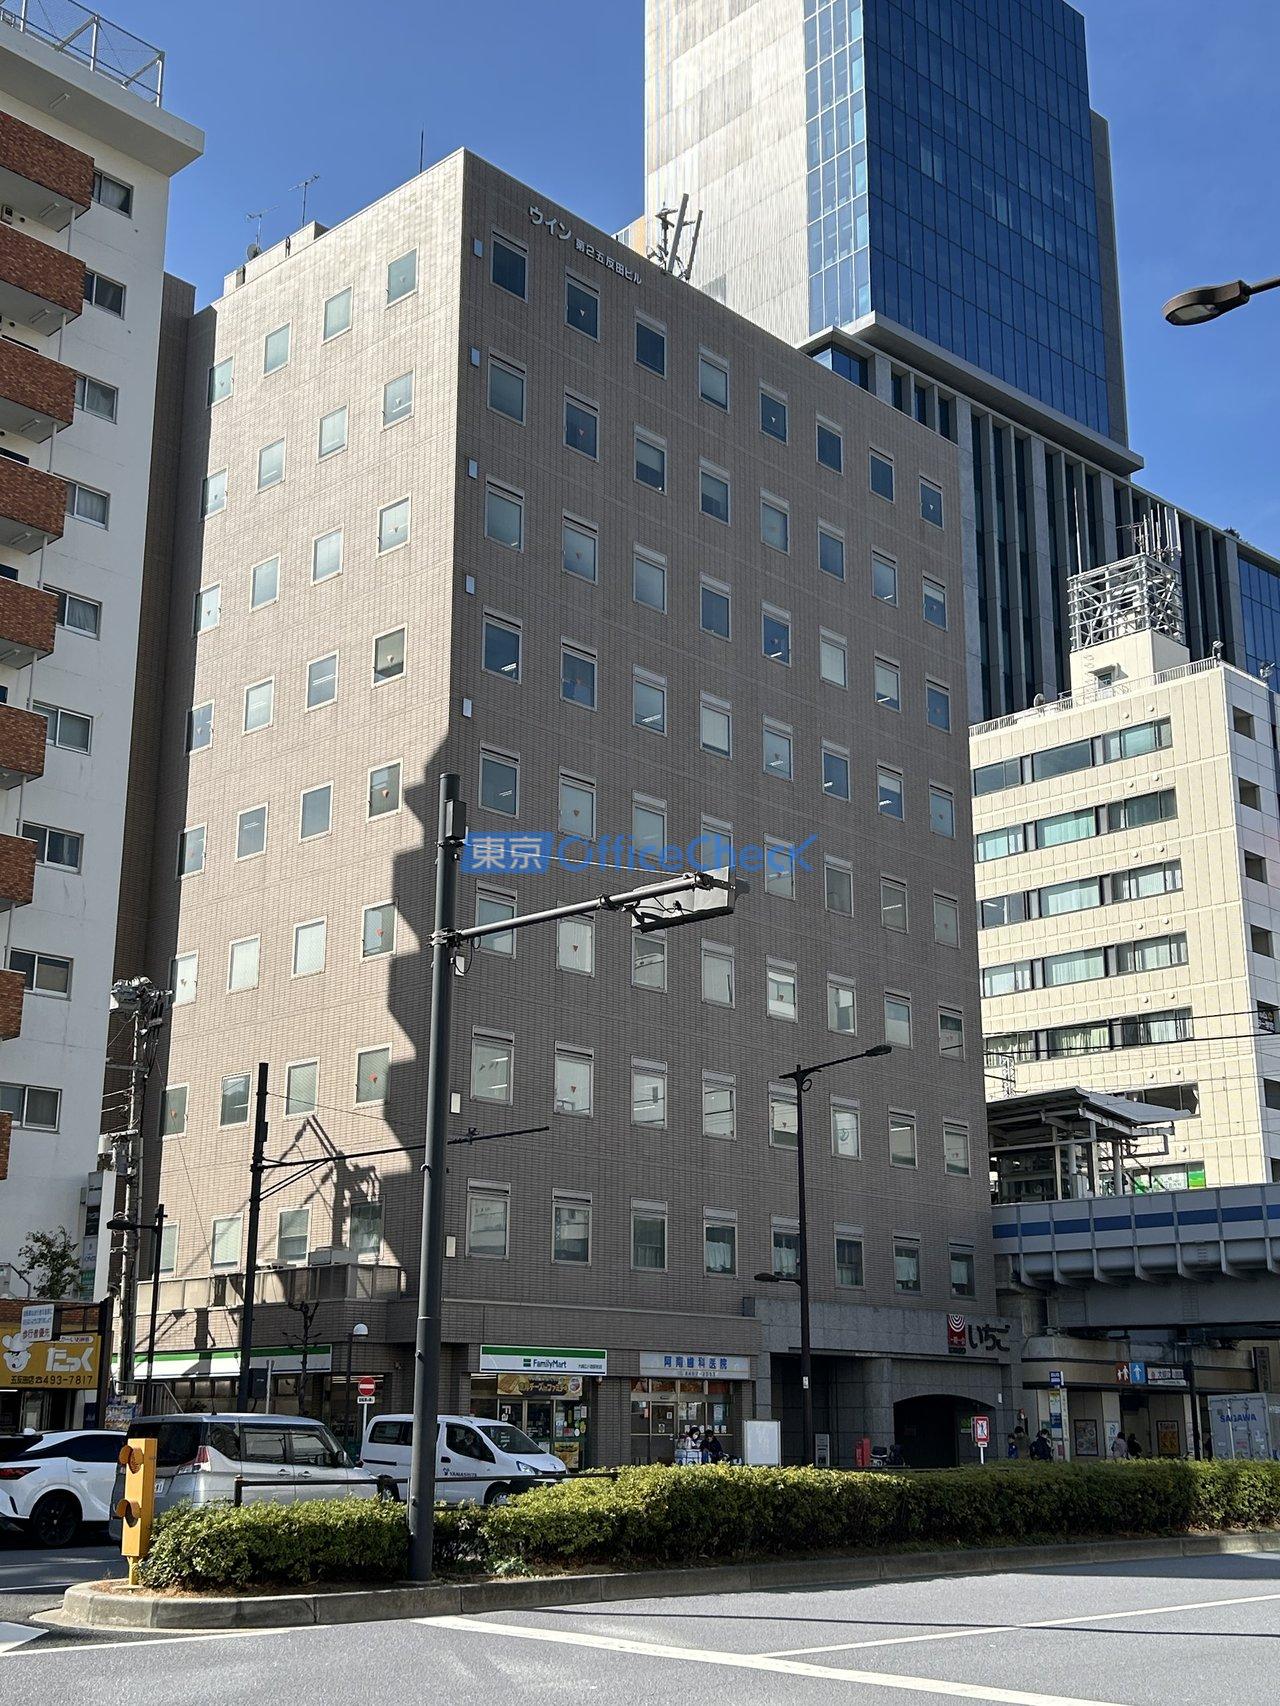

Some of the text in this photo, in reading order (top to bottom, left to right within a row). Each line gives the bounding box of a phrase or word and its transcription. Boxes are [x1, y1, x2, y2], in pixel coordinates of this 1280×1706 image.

[529, 205, 572, 240] ウイン
[968, 1324, 1011, 1352] いちご
[46, 1347, 94, 1372] たっく
[533, 1358, 567, 1369] FamilyMart
[664, 1355, 728, 1370] 阿南歯科医院
[43, 1375, 93, 1386] 493-7817
[1219, 1413, 1257, 1423] SAGAWA
